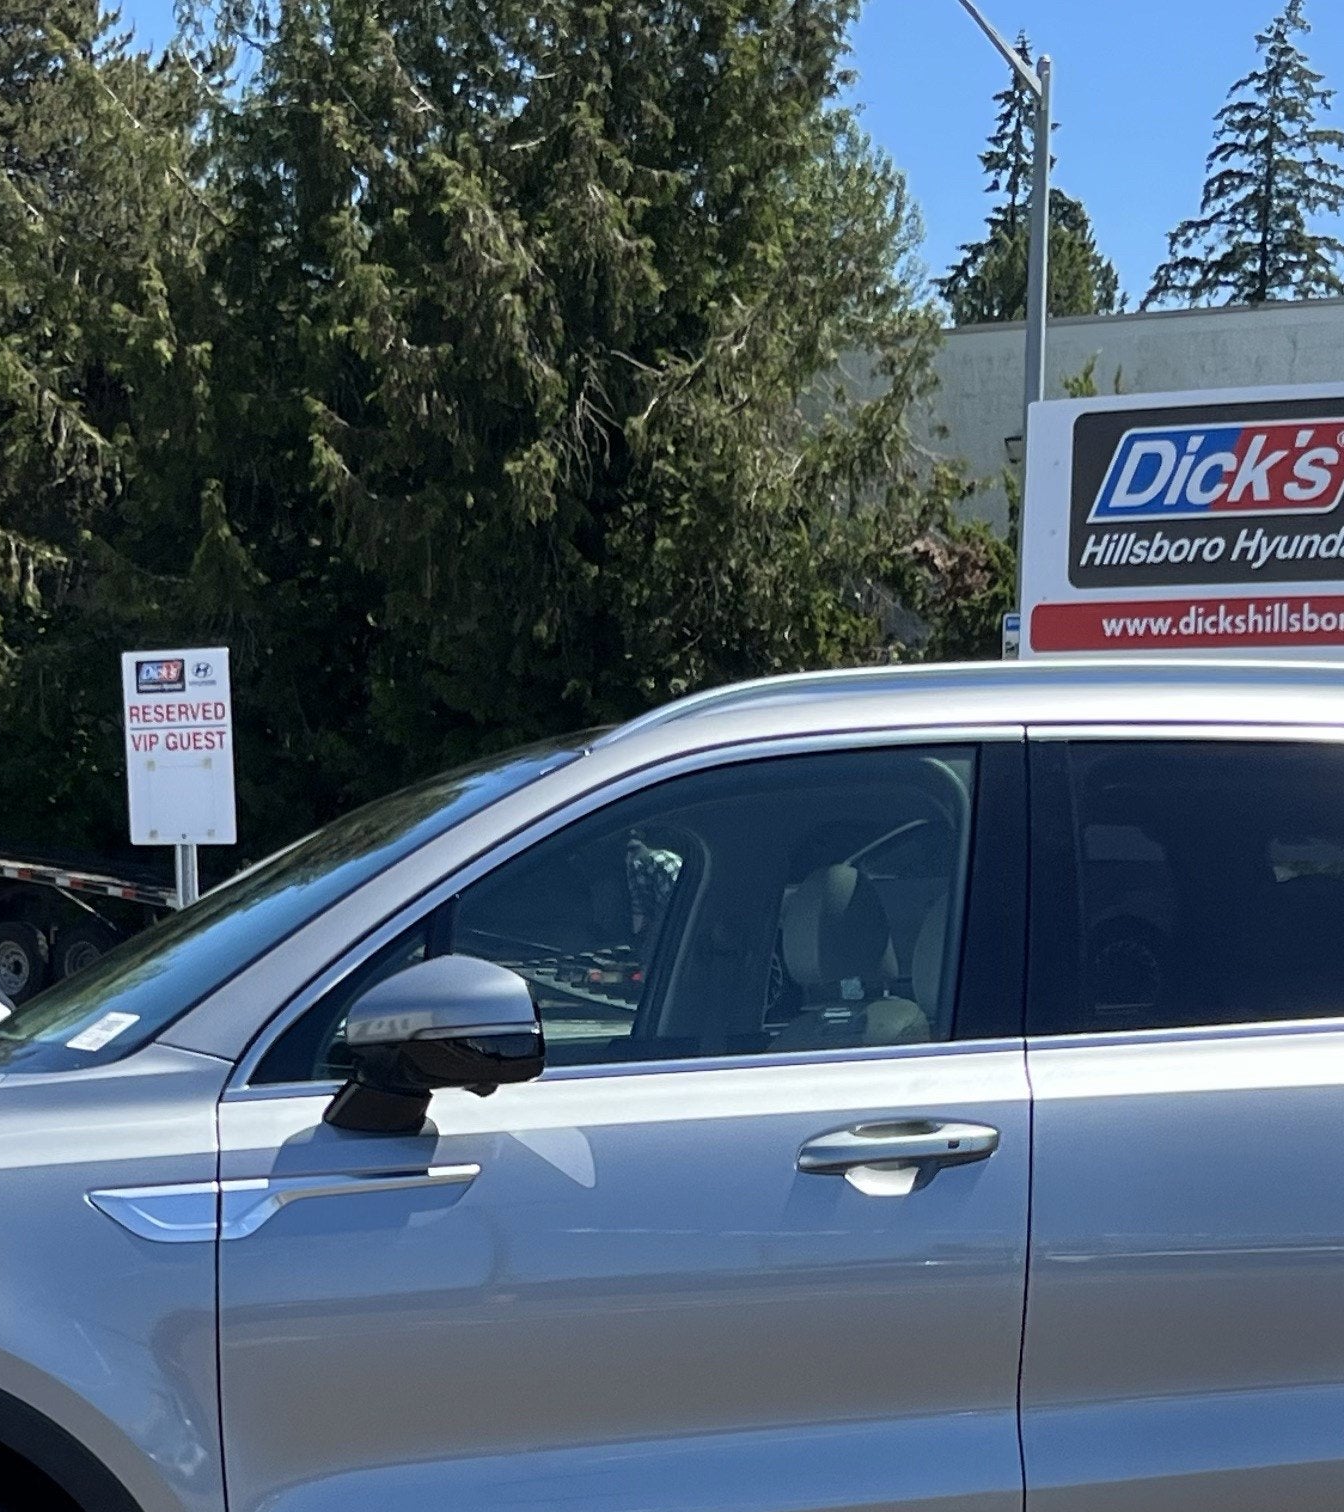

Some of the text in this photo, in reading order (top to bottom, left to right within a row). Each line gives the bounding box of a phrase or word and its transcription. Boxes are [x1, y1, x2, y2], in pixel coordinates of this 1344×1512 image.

[1079, 531, 1227, 567] Hillsboro
[129, 702, 226, 723] RESERVED
[131, 731, 227, 751] VIP GUEST
